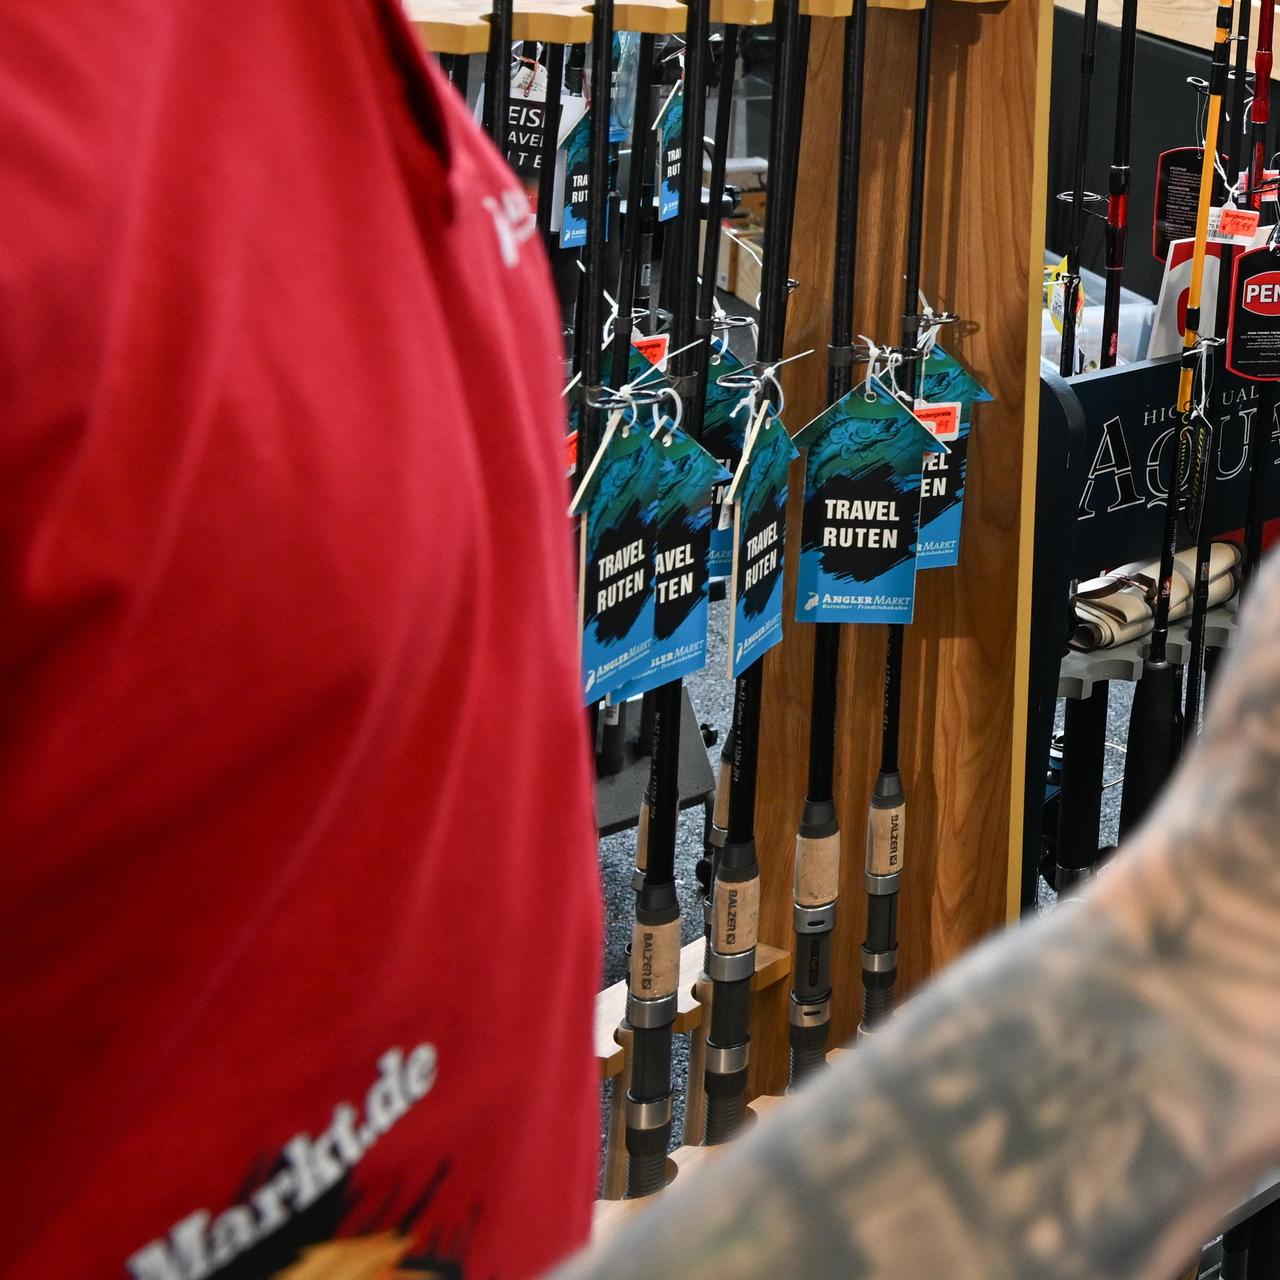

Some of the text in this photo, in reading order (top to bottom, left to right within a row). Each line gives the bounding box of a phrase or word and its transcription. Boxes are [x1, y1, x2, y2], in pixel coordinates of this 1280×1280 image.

[507, 105, 546, 129] EIS
[507, 130, 544, 148] AVE
[572, 173, 589, 188] TRA
[667, 162, 681, 178] RUT
[571, 189, 589, 204] RUT
[824, 498, 901, 522] TRAVEL
[746, 521, 779, 562] TRAVEL
[822, 526, 899, 549] RUTEN
[597, 538, 646, 583] TRAVEL
[654, 542, 695, 577] AVEL
[745, 548, 778, 591] RUTEN
[596, 568, 645, 615] RUTEN
[657, 571, 694, 605] TEN
[889, 813, 900, 858] BALZER
[727, 888, 738, 934] BALZER
[641, 932, 654, 980] BALZER
